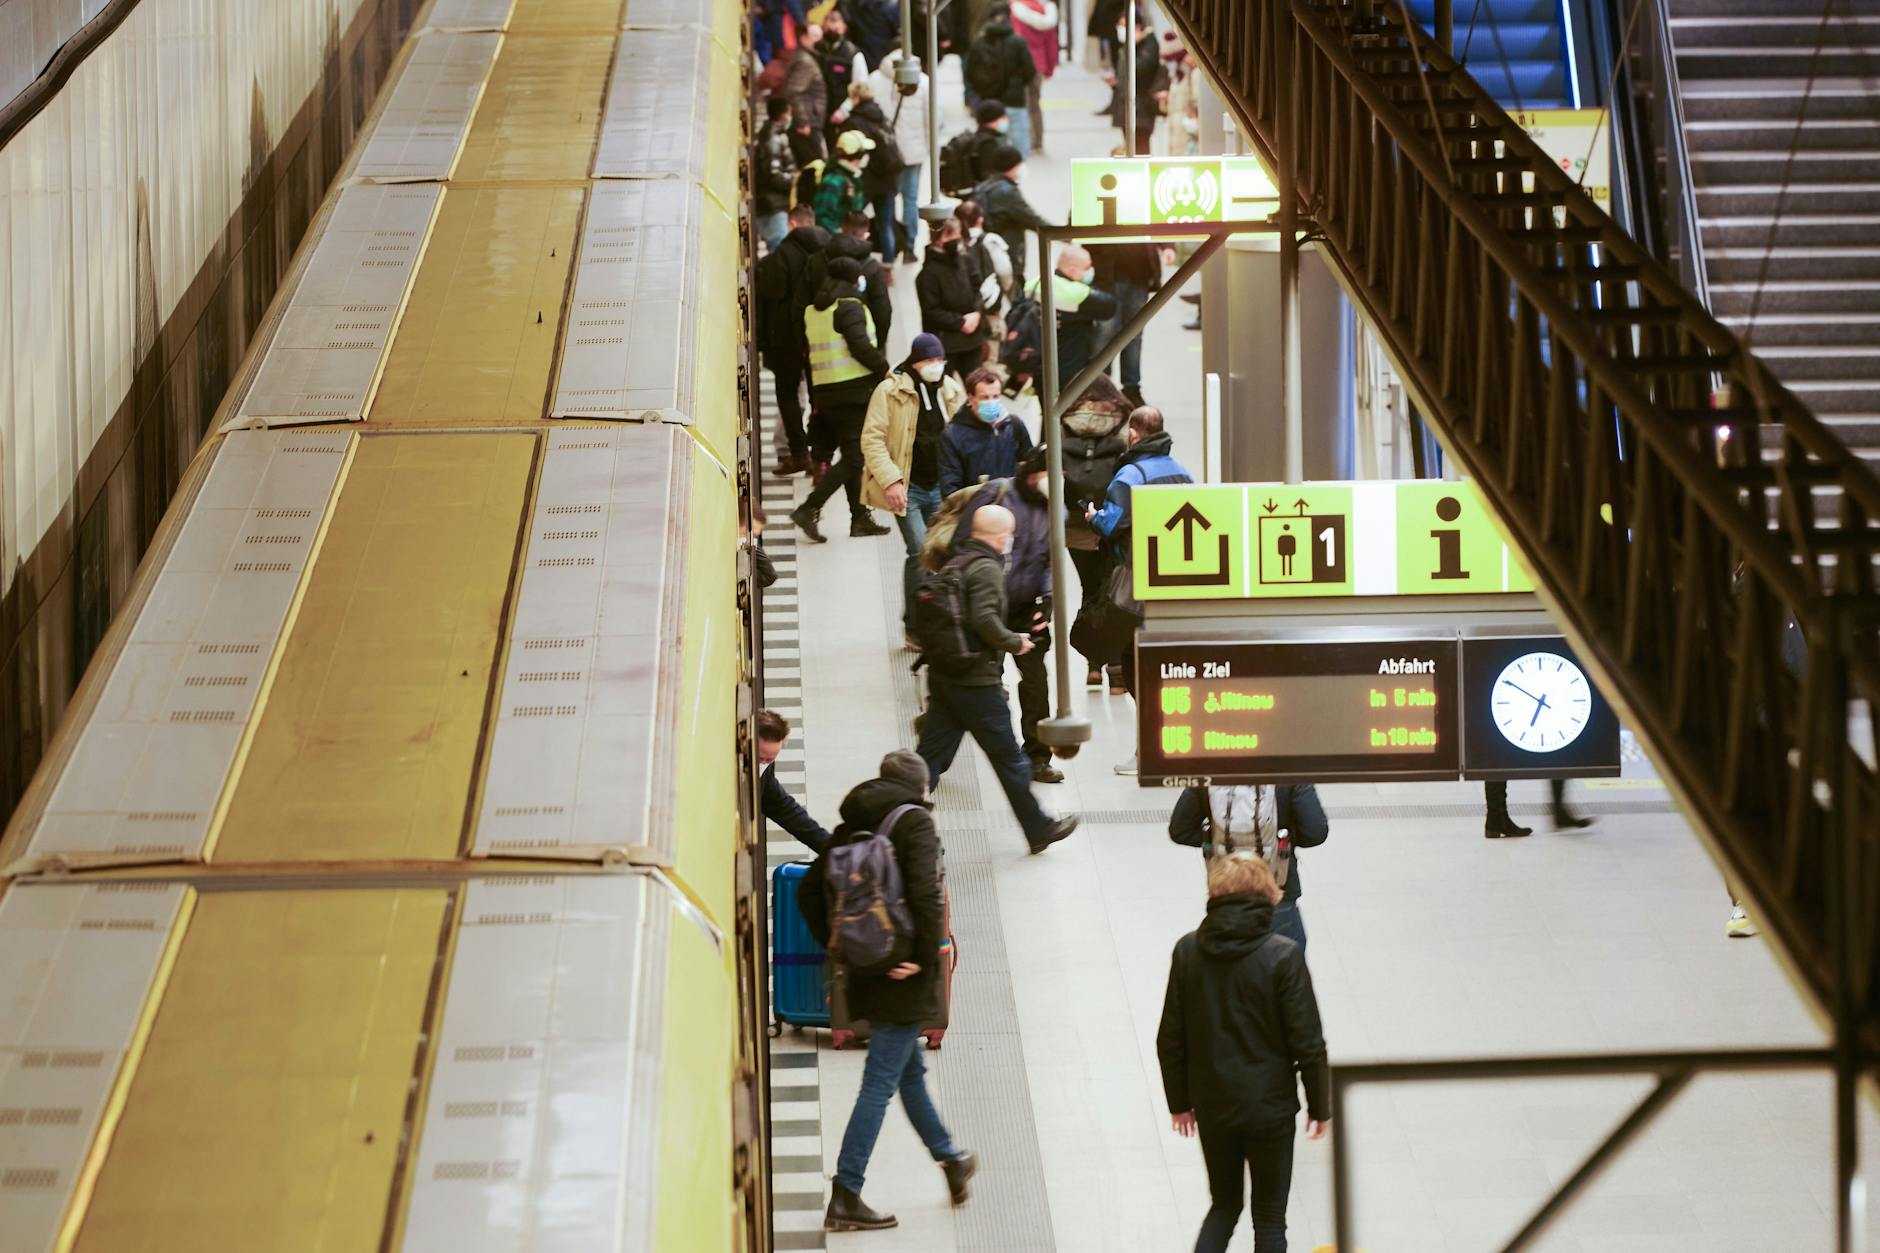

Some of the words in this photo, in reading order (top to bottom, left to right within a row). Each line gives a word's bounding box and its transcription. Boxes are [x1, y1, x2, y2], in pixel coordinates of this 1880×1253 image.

[1317, 527, 1336, 567] 1
[1160, 662, 1197, 679] Linie
[1202, 661, 1231, 678] Ziel
[1378, 657, 1436, 675] Abfahrt
[1161, 686, 1192, 715] U5
[1161, 725, 1192, 754] U5
[1161, 775, 1199, 788] Gleis
[1203, 775, 1213, 787] 2
